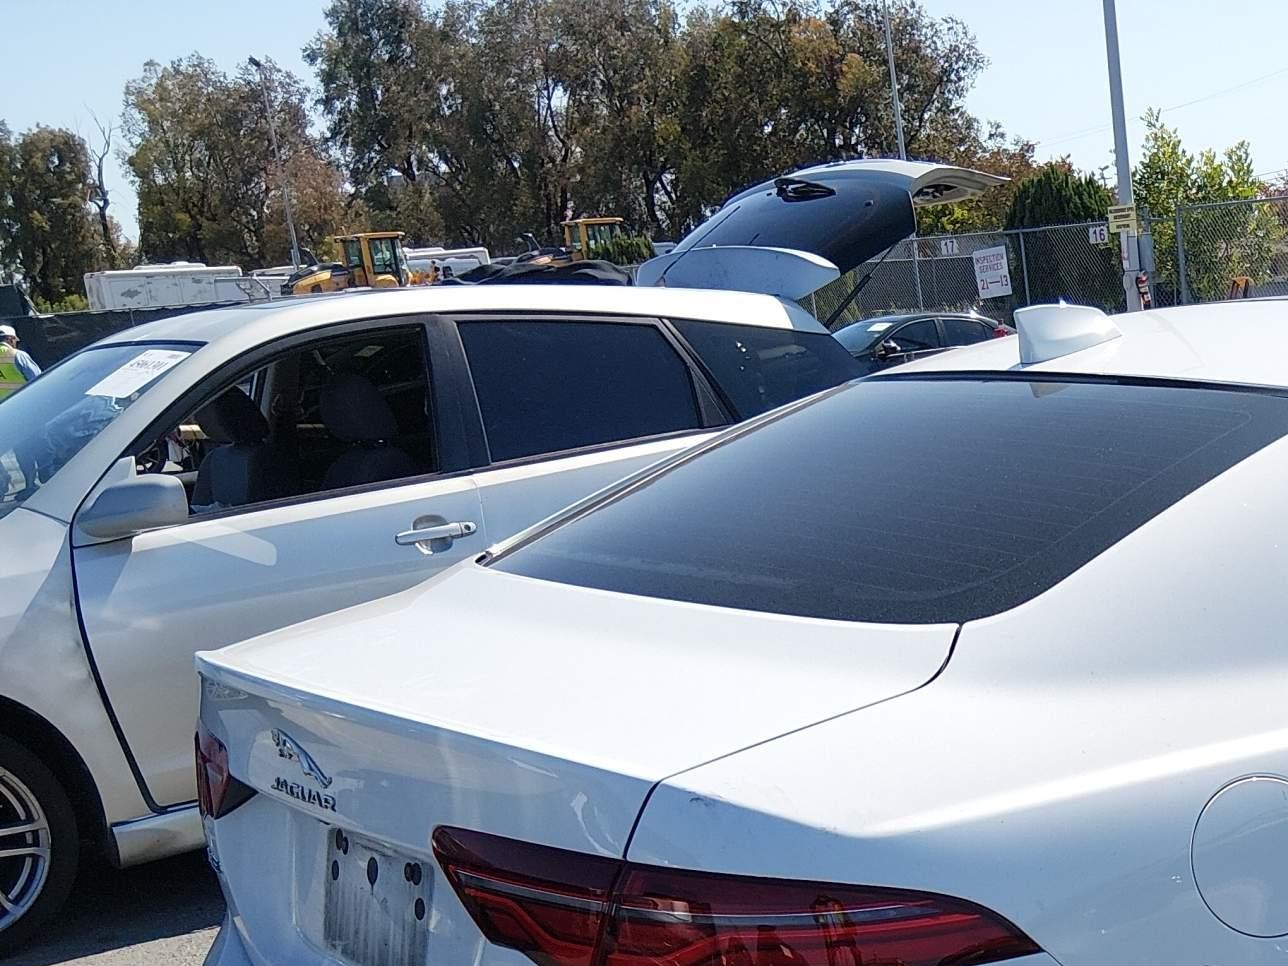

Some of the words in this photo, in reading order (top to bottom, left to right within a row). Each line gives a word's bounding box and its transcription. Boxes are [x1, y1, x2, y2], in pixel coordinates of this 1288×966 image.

[1092, 228, 1106, 242] 16
[944, 240, 955, 254] 17
[270, 776, 337, 812] JAGUAR
